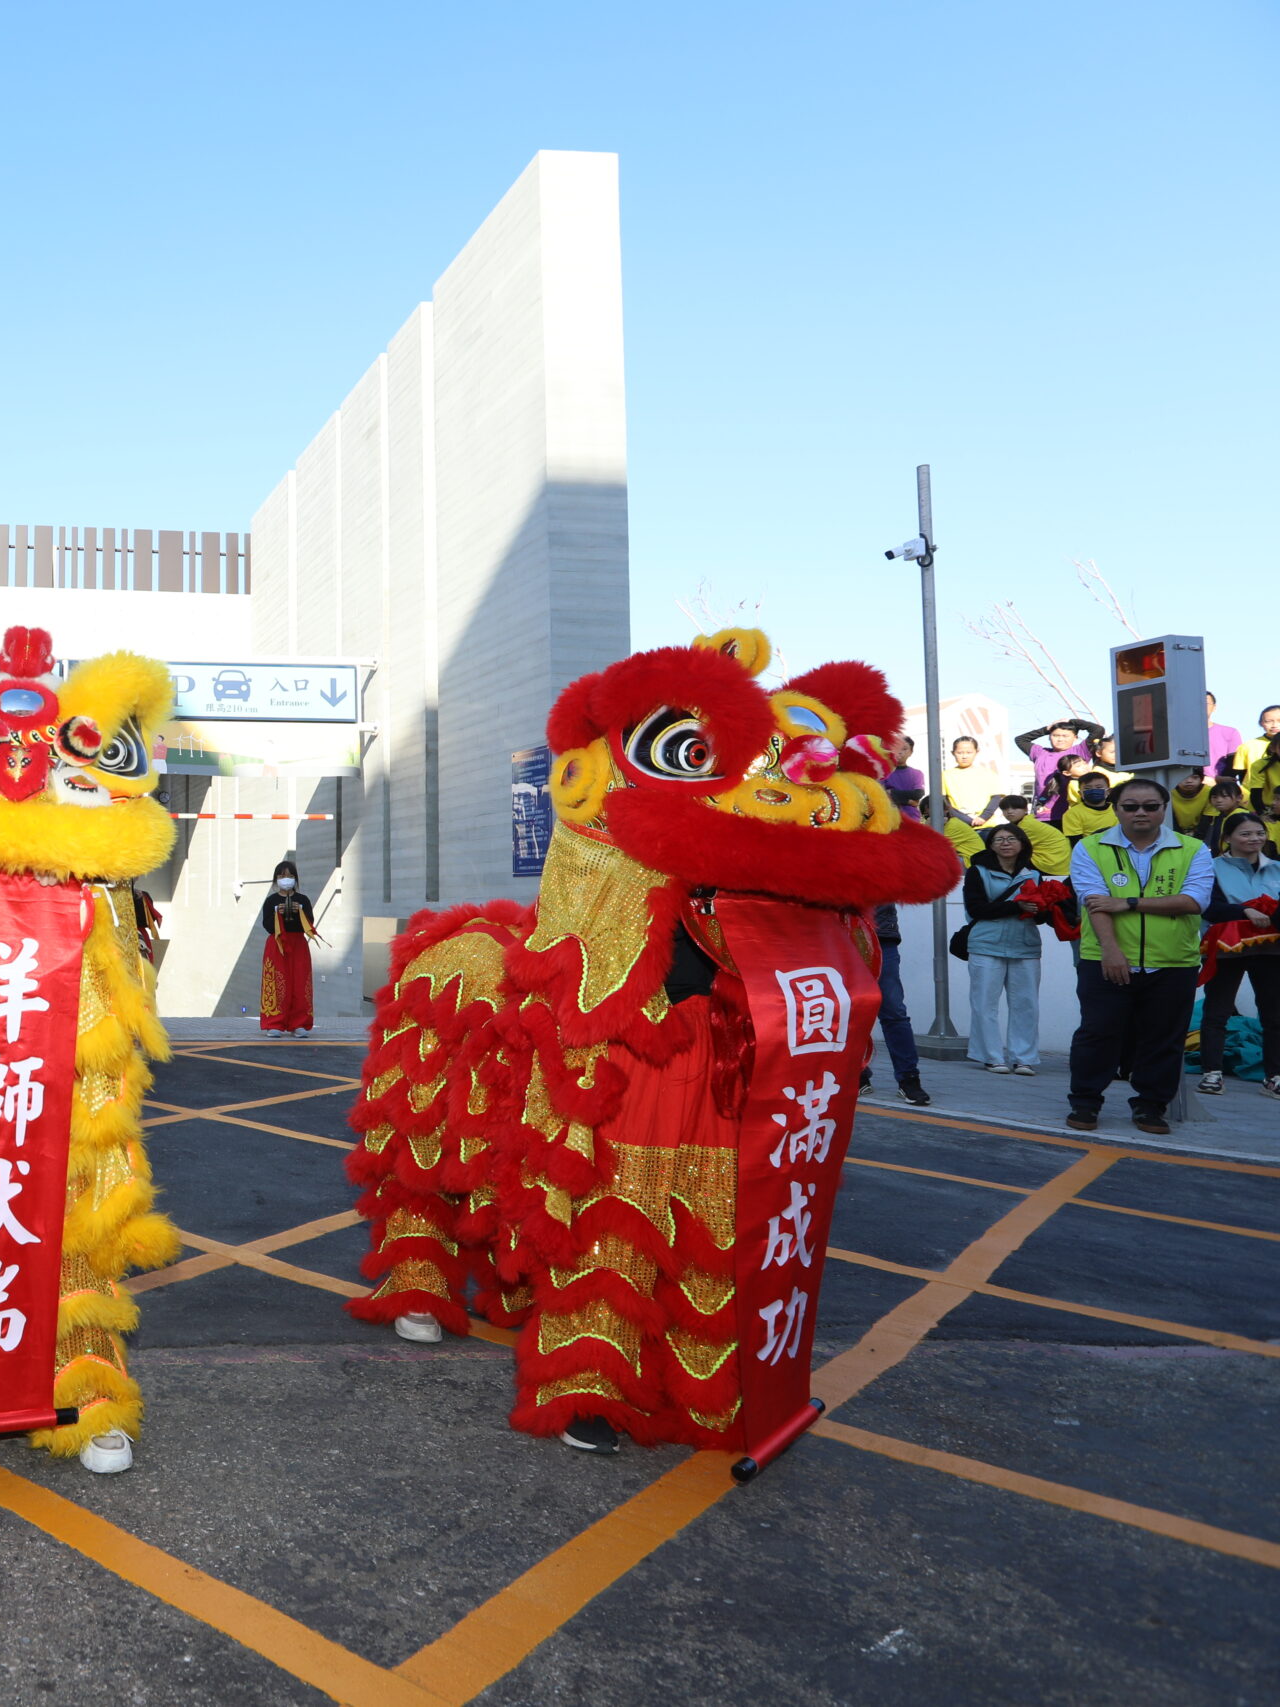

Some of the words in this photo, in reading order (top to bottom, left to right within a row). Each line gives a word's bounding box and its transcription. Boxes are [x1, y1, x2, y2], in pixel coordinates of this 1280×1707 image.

[270, 678, 310, 692] 入口
[270, 698, 310, 707] Entrance
[755, 966, 852, 1366] 圓滿成功
